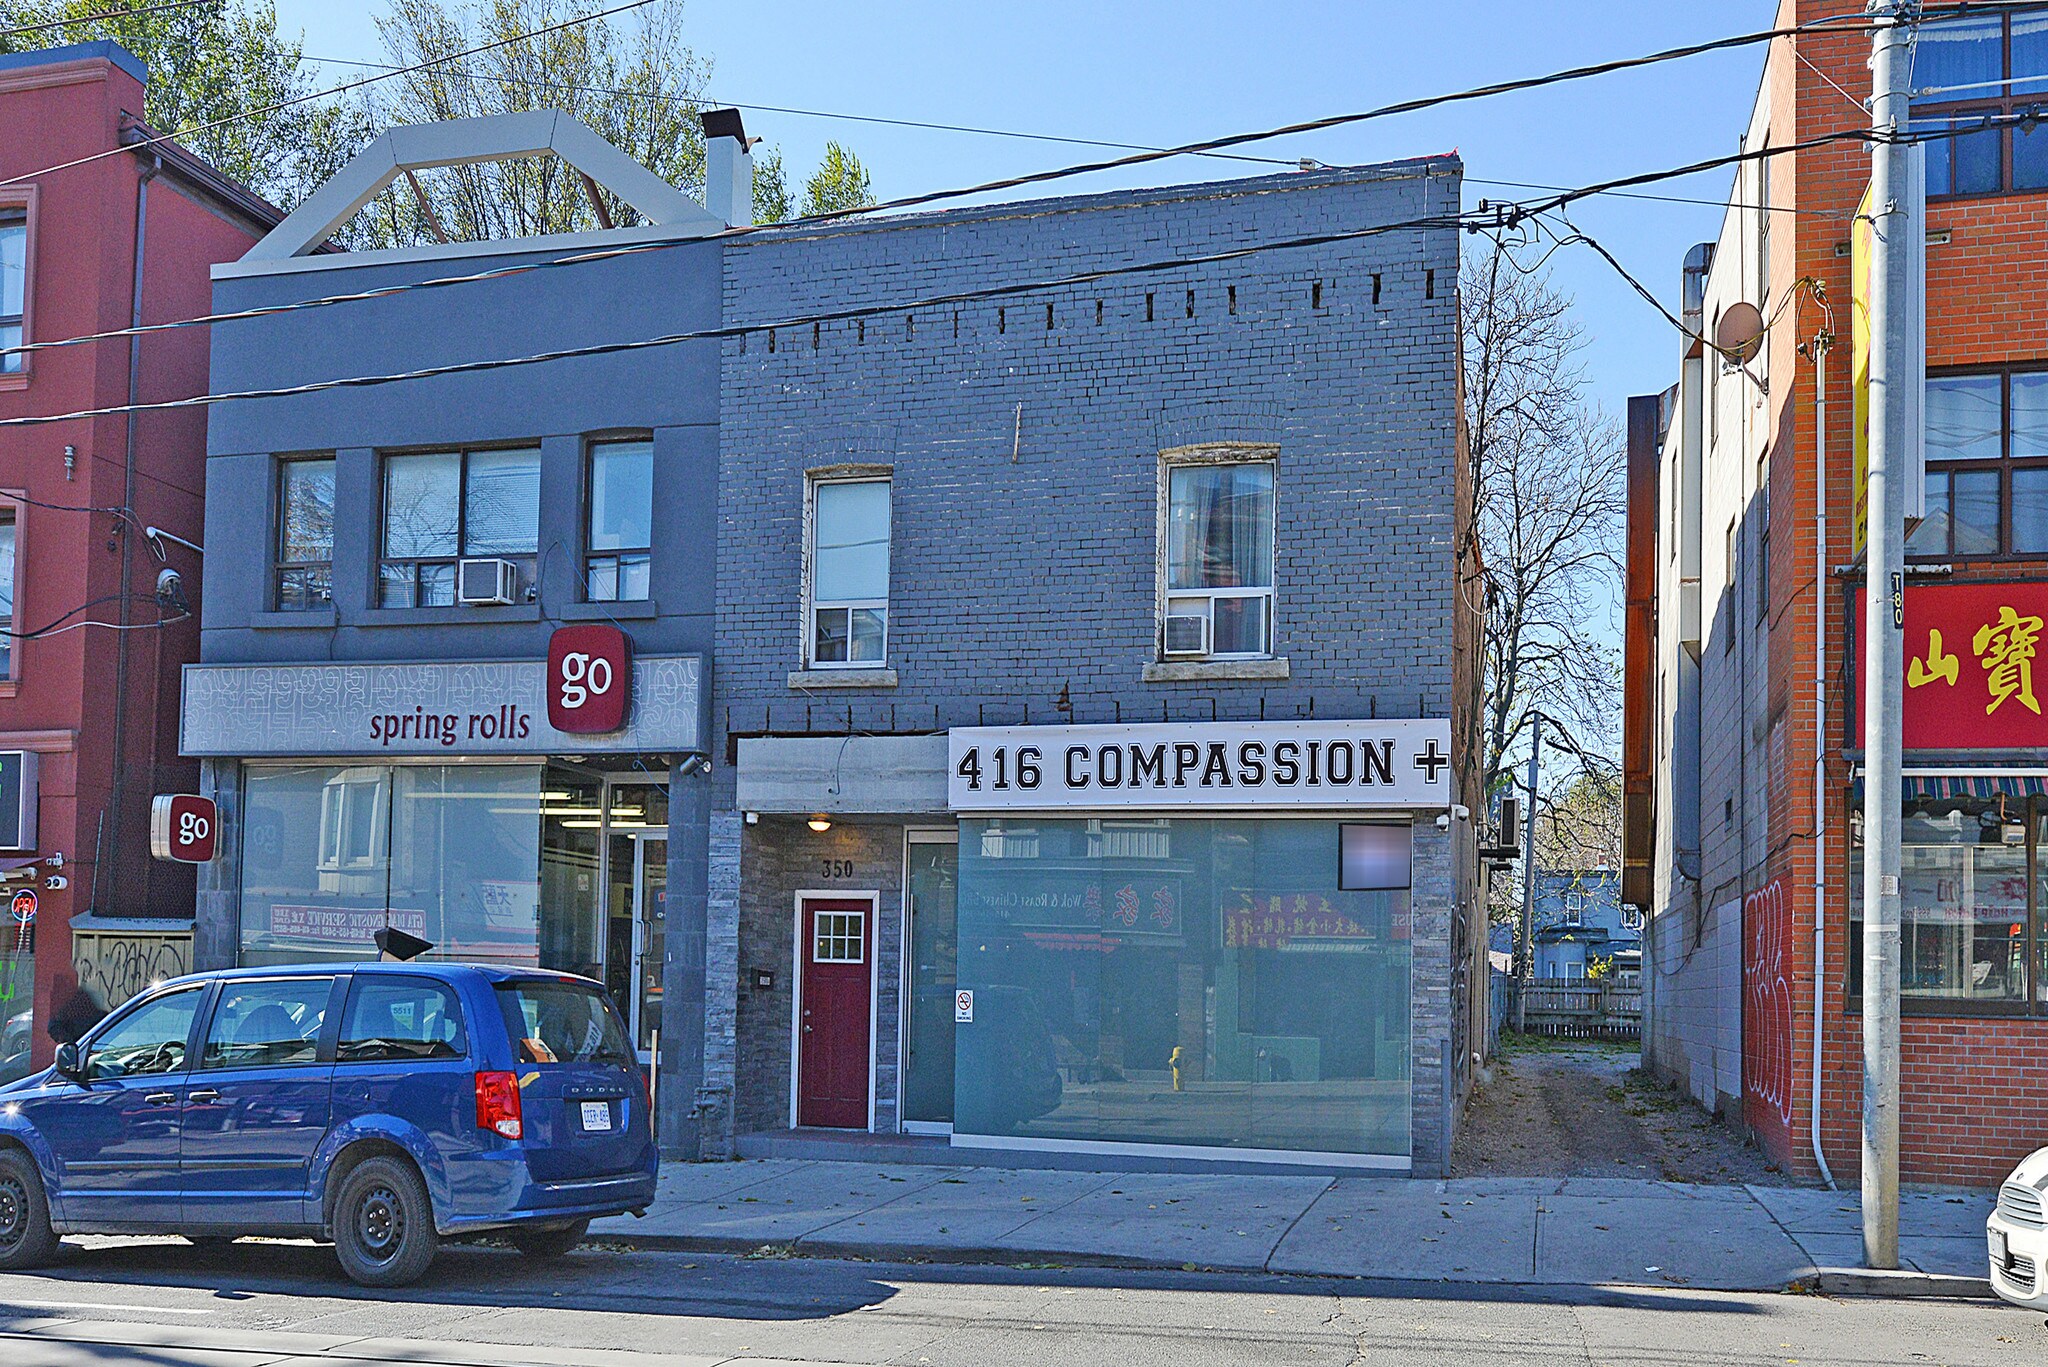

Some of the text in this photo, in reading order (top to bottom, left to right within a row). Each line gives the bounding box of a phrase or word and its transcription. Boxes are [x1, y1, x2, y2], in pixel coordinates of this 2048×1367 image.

[1893, 574, 1903, 625] T80
[560, 651, 613, 710] go
[369, 703, 531, 747] spring rolls
[956, 744, 1043, 791] 416
[1063, 738, 1396, 791] COMPASSION
[179, 811, 209, 845] go
[821, 859, 854, 878] 350
[13, 897, 36, 913] OPEN
